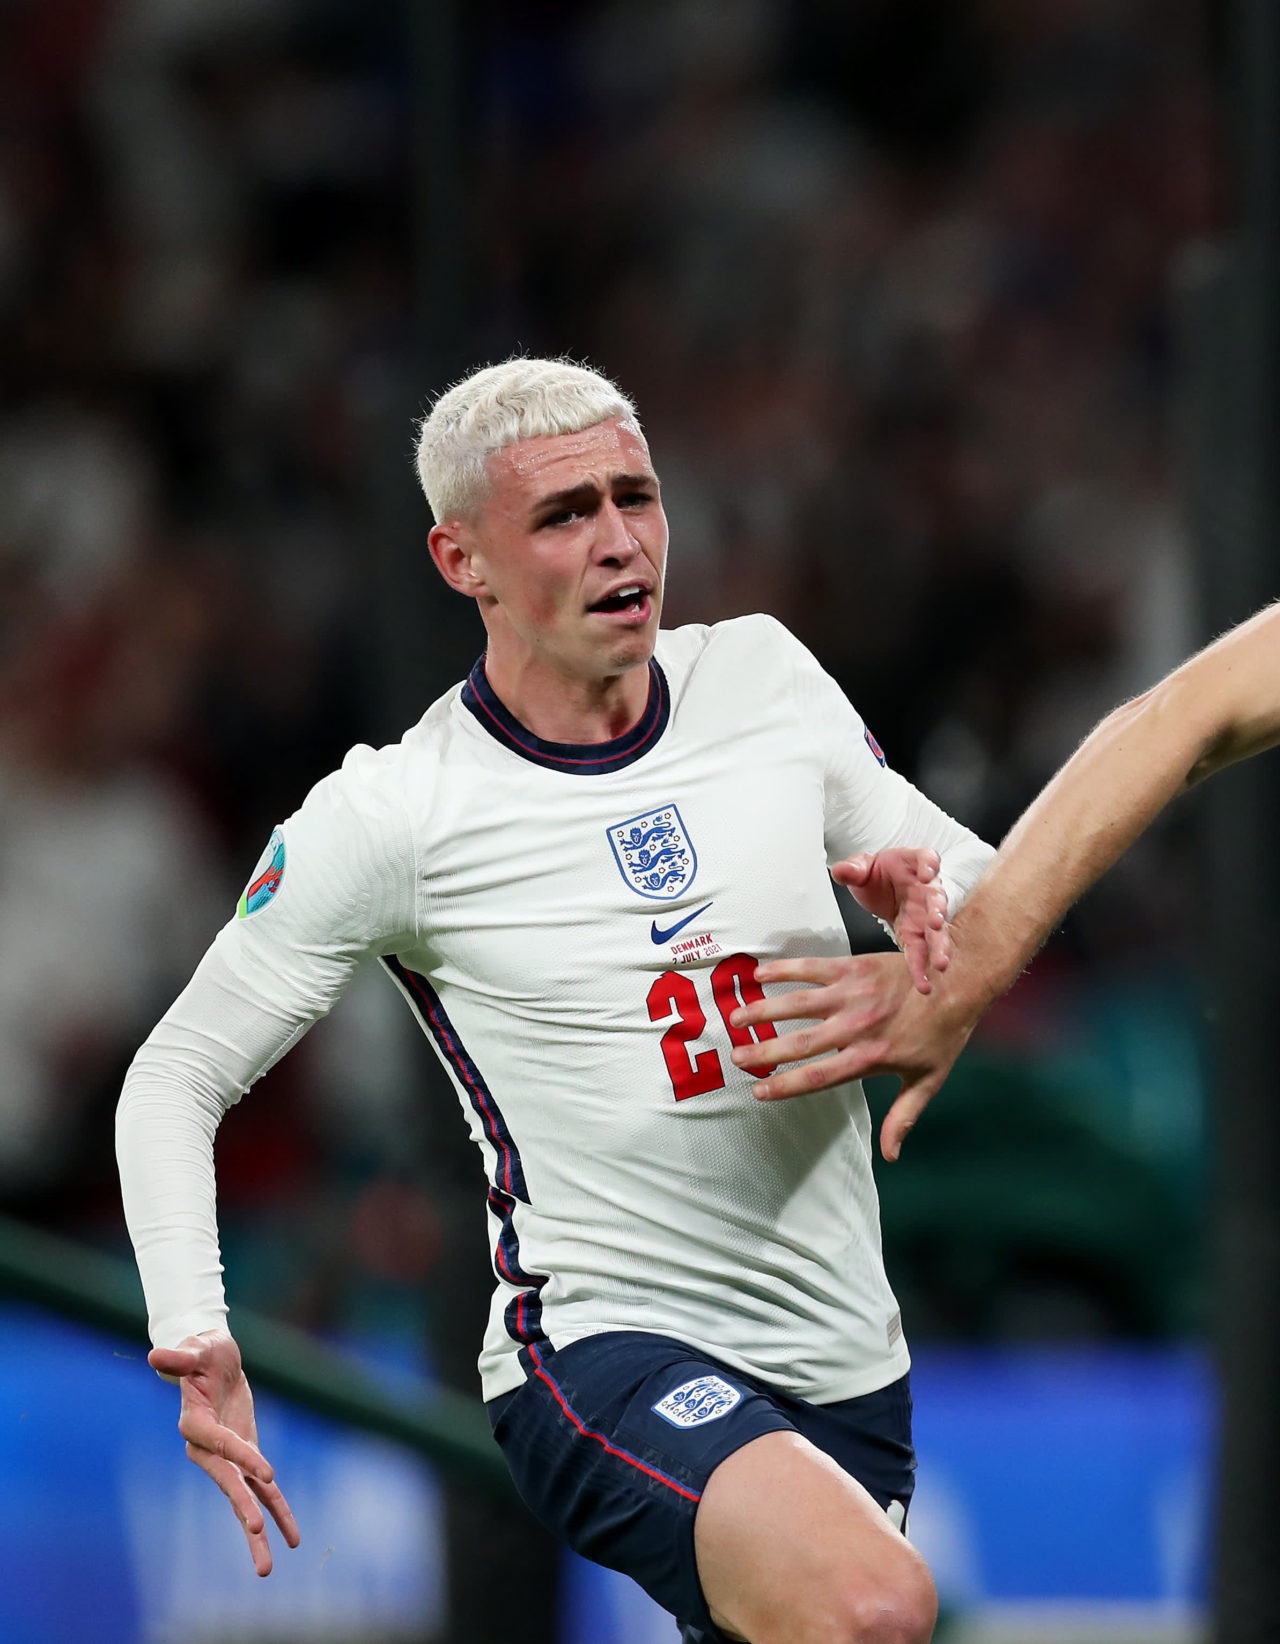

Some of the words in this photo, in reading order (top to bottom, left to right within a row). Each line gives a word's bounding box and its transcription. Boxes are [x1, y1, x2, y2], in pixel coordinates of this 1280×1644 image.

[671, 933, 713, 955] DENMARK
[681, 950, 701, 964] JULY
[703, 943, 722, 957] 2021
[646, 953, 778, 1102] 20
